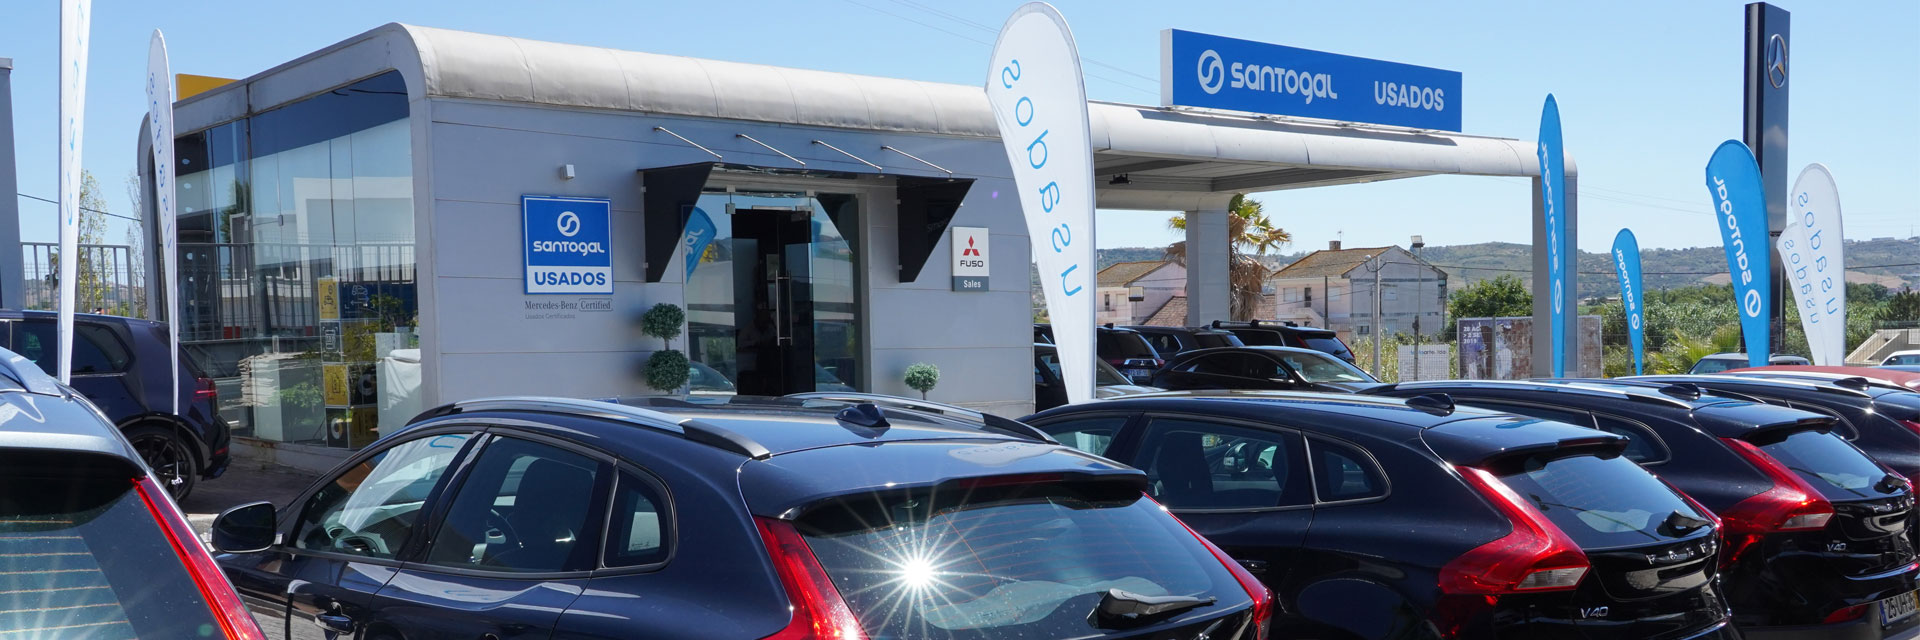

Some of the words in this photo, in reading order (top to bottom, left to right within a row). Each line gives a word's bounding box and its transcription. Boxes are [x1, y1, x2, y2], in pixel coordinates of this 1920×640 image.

[1374, 81, 1444, 112] USADOS
[960, 260, 984, 268] FUSO
[534, 271, 606, 286] USADOS
[963, 279, 981, 288] Sales
[524, 300, 578, 310] Mercedes-Benz
[580, 300, 611, 310] Certified
[1826, 542, 1847, 552] V40
[1580, 606, 1609, 619] V40
